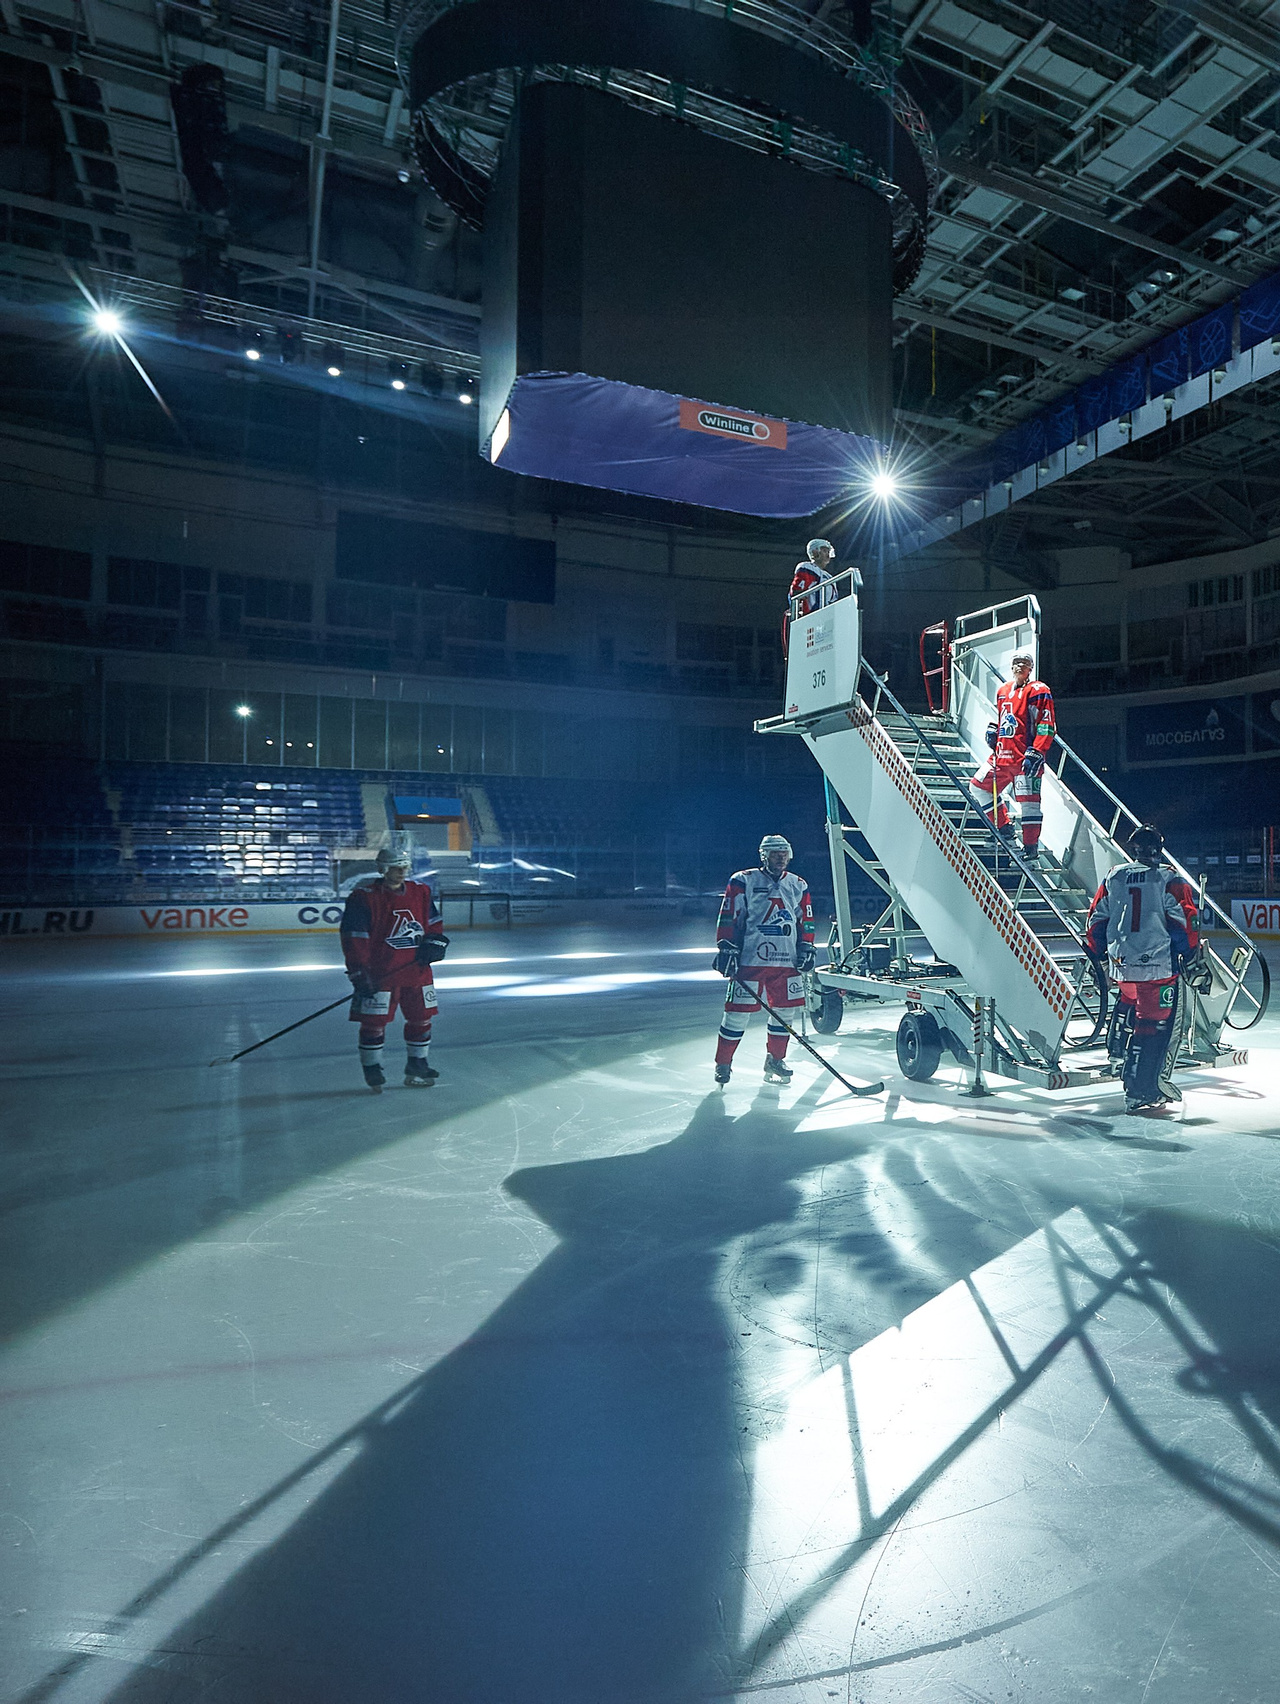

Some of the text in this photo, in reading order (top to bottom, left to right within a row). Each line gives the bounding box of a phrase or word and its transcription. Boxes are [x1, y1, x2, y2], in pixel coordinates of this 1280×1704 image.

[704, 414, 750, 433] Winline
[812, 669, 826, 689] 376
[140, 908, 249, 929] vanke
[1129, 887, 1141, 932] 1
